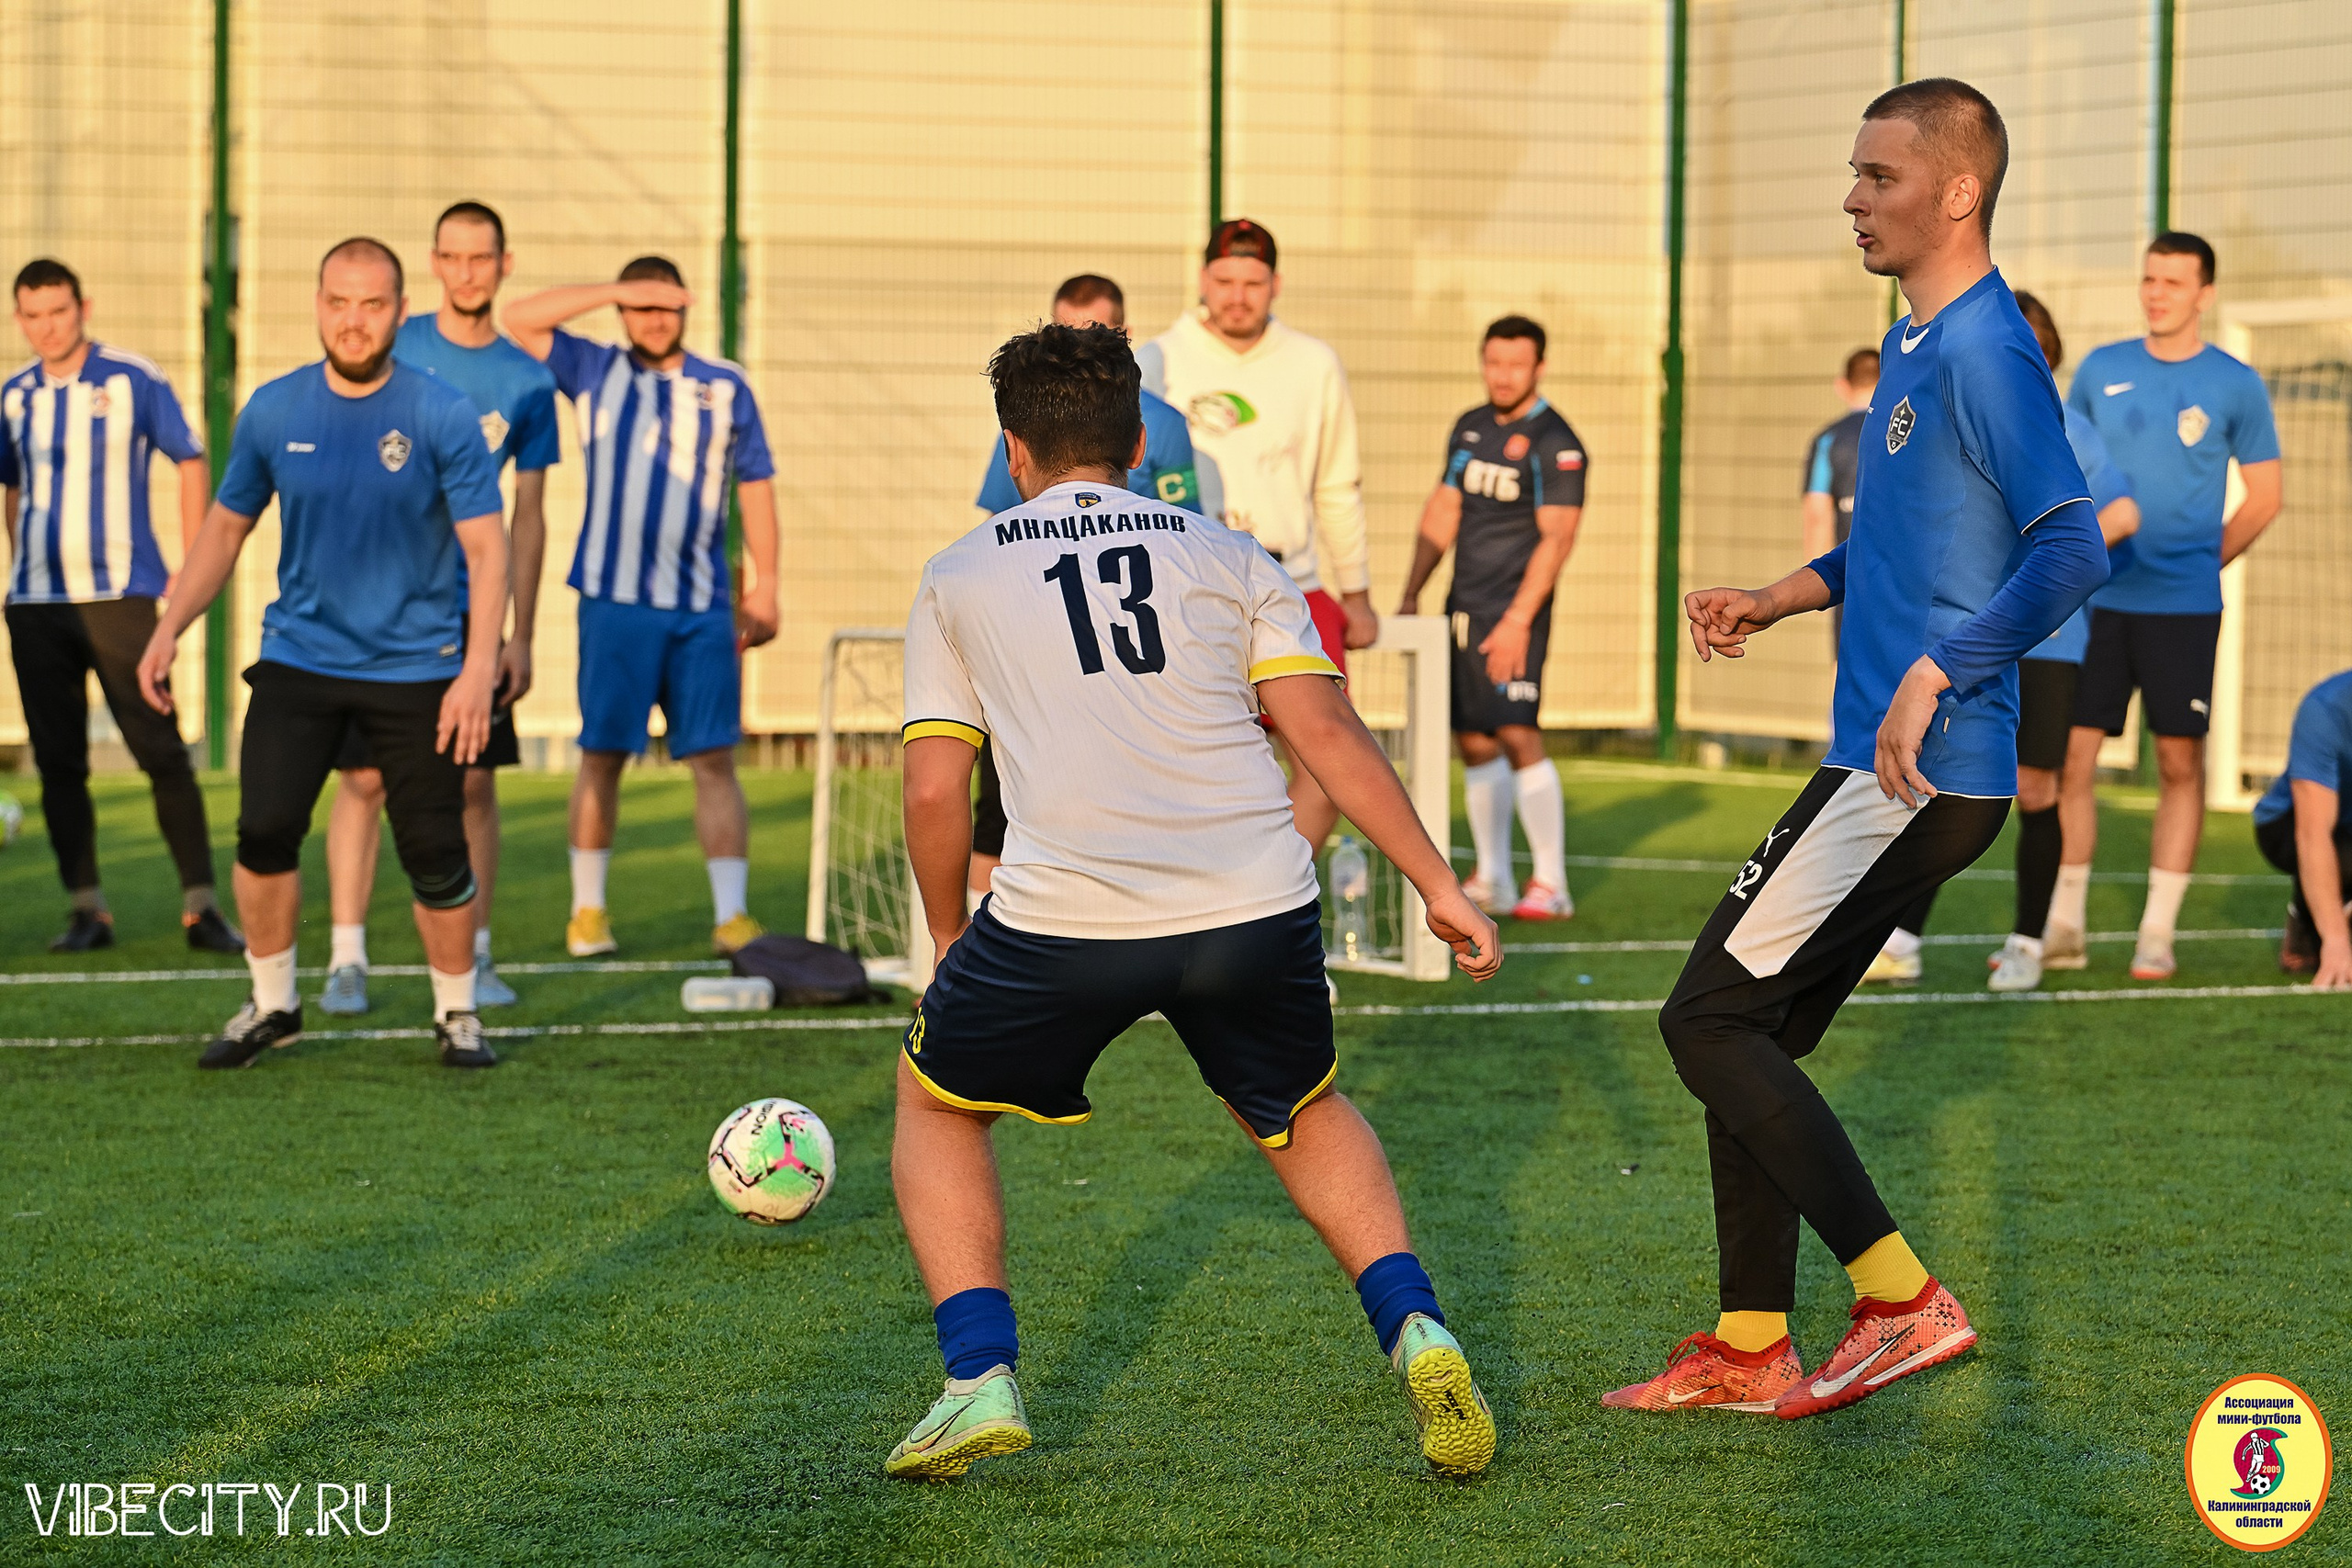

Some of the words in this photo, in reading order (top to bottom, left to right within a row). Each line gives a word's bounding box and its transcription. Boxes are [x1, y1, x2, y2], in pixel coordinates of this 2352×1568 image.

[1890, 417, 1908, 436] FC
[995, 513, 1186, 546] МНАЦАКАНОВ
[1043, 543, 1166, 675] 13
[1729, 859, 1763, 900] 52
